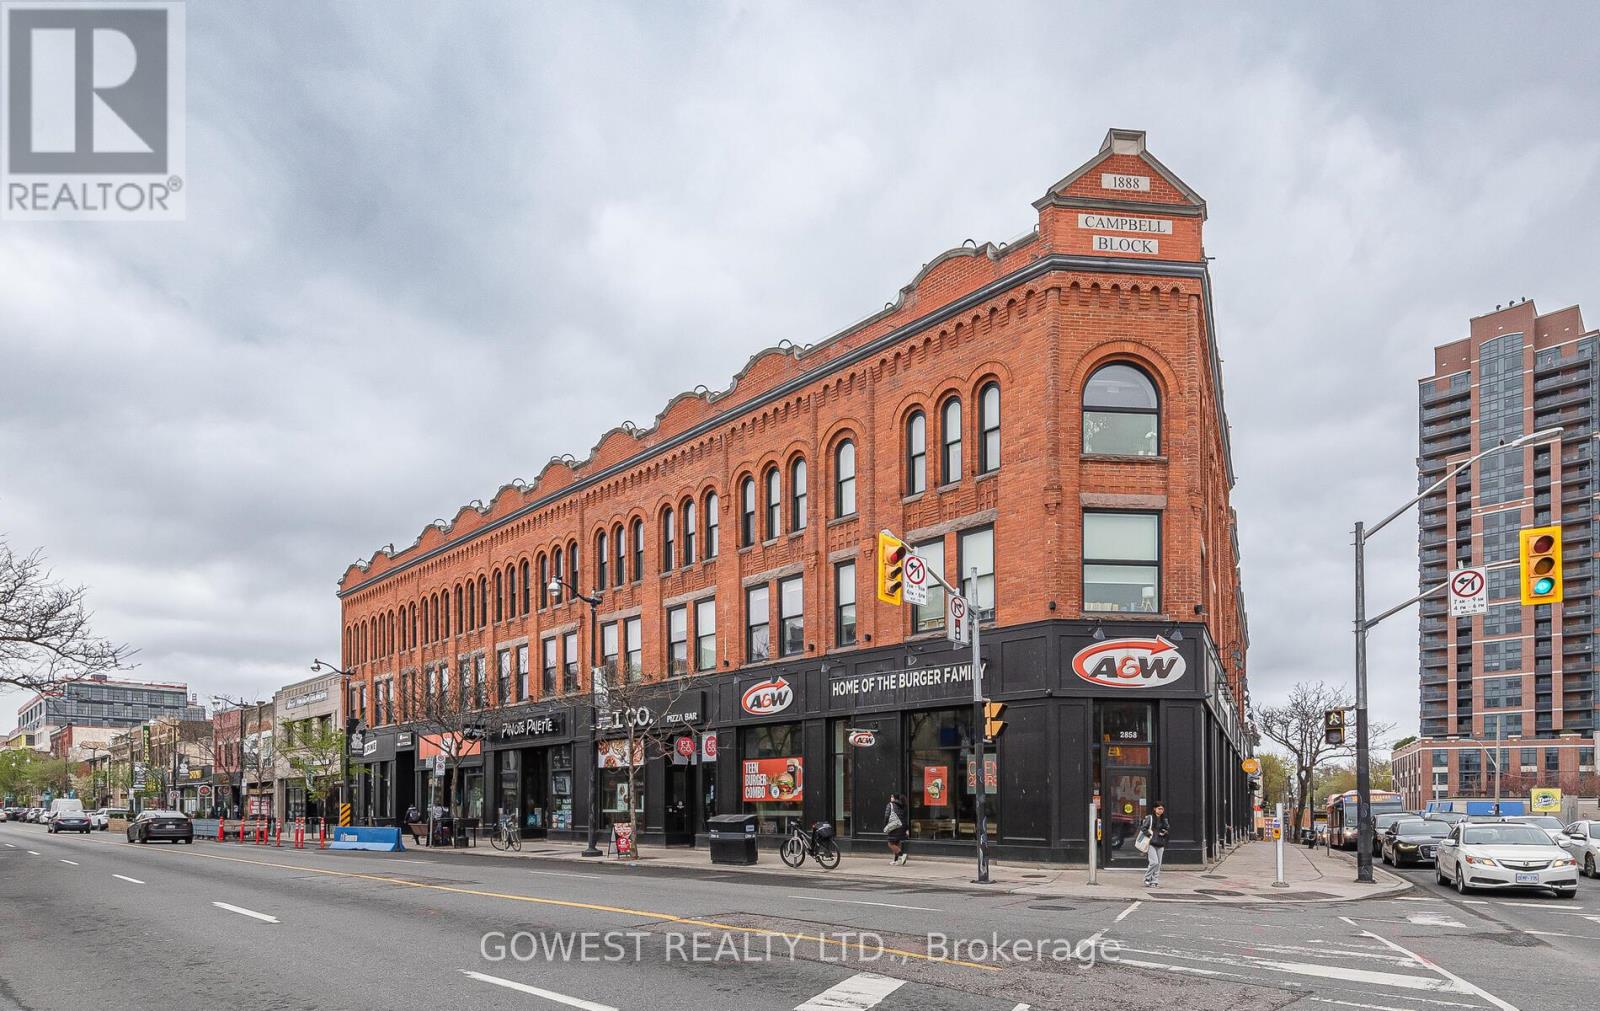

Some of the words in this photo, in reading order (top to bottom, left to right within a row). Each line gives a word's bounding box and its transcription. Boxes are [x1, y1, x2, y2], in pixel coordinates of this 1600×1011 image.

[1113, 176, 1140, 189] 1888
[1085, 215, 1166, 233] CAMPBELL
[1098, 236, 1153, 253] BLOCK
[1088, 655, 1179, 679] A&W
[832, 680, 860, 697] HOME
[861, 677, 876, 693] OF
[877, 675, 898, 691] THE
[898, 669, 942, 689] BURGER
[750, 689, 790, 709] A&W
[684, 712, 698, 721] BAR
[526, 717, 553, 736] PALETTE
[1119, 731, 1138, 739] 2858
[745, 761, 759, 774] TEEN
[968, 760, 997, 776] OEN
[745, 773, 767, 786] BURGER
[745, 786, 766, 799] COMBO
